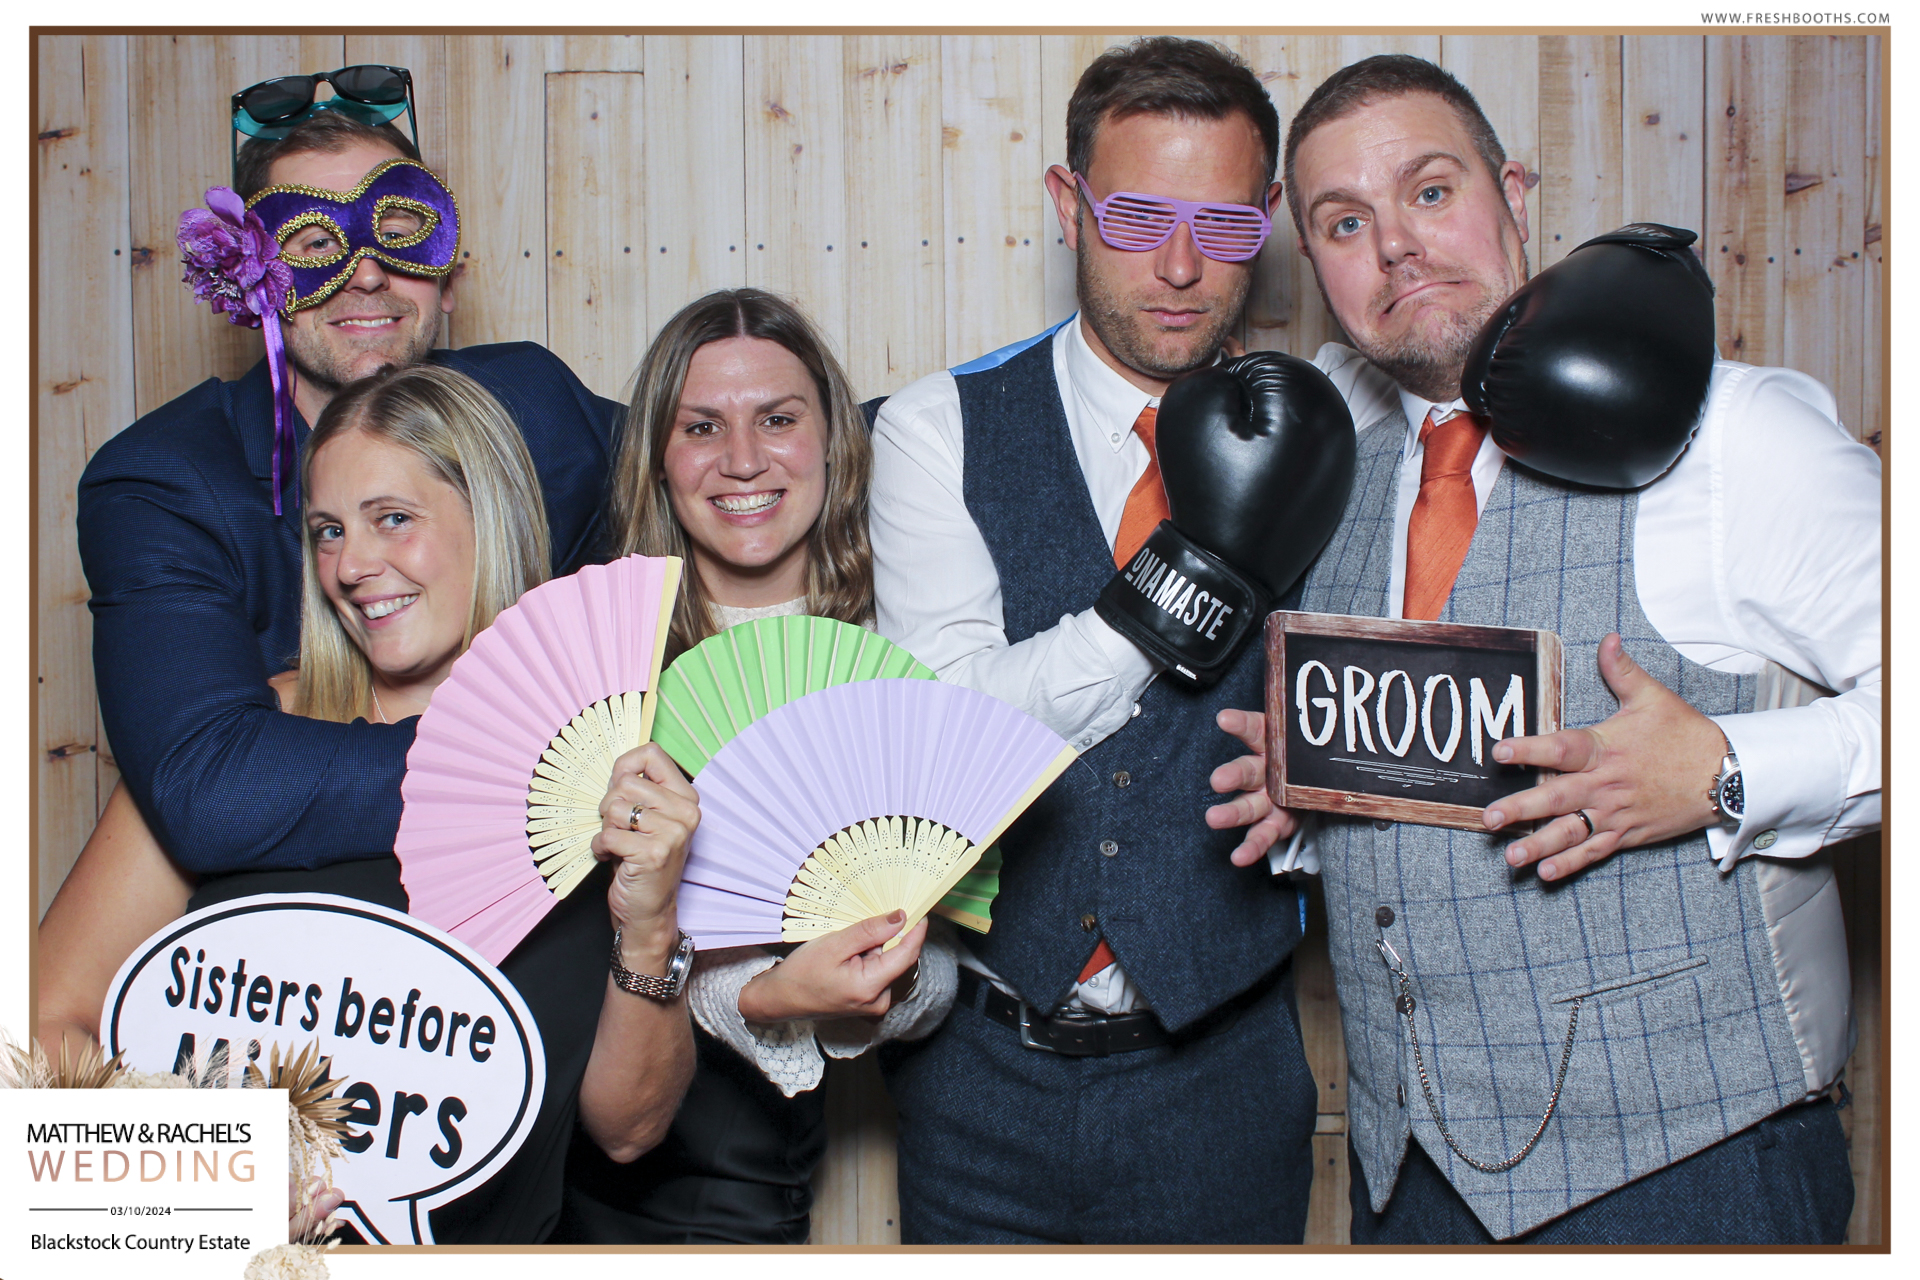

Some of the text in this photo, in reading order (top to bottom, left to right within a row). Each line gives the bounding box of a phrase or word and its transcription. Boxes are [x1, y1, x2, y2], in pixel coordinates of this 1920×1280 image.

[1295, 659, 1526, 769] GROOM
[165, 945, 497, 1063] Sisters before
